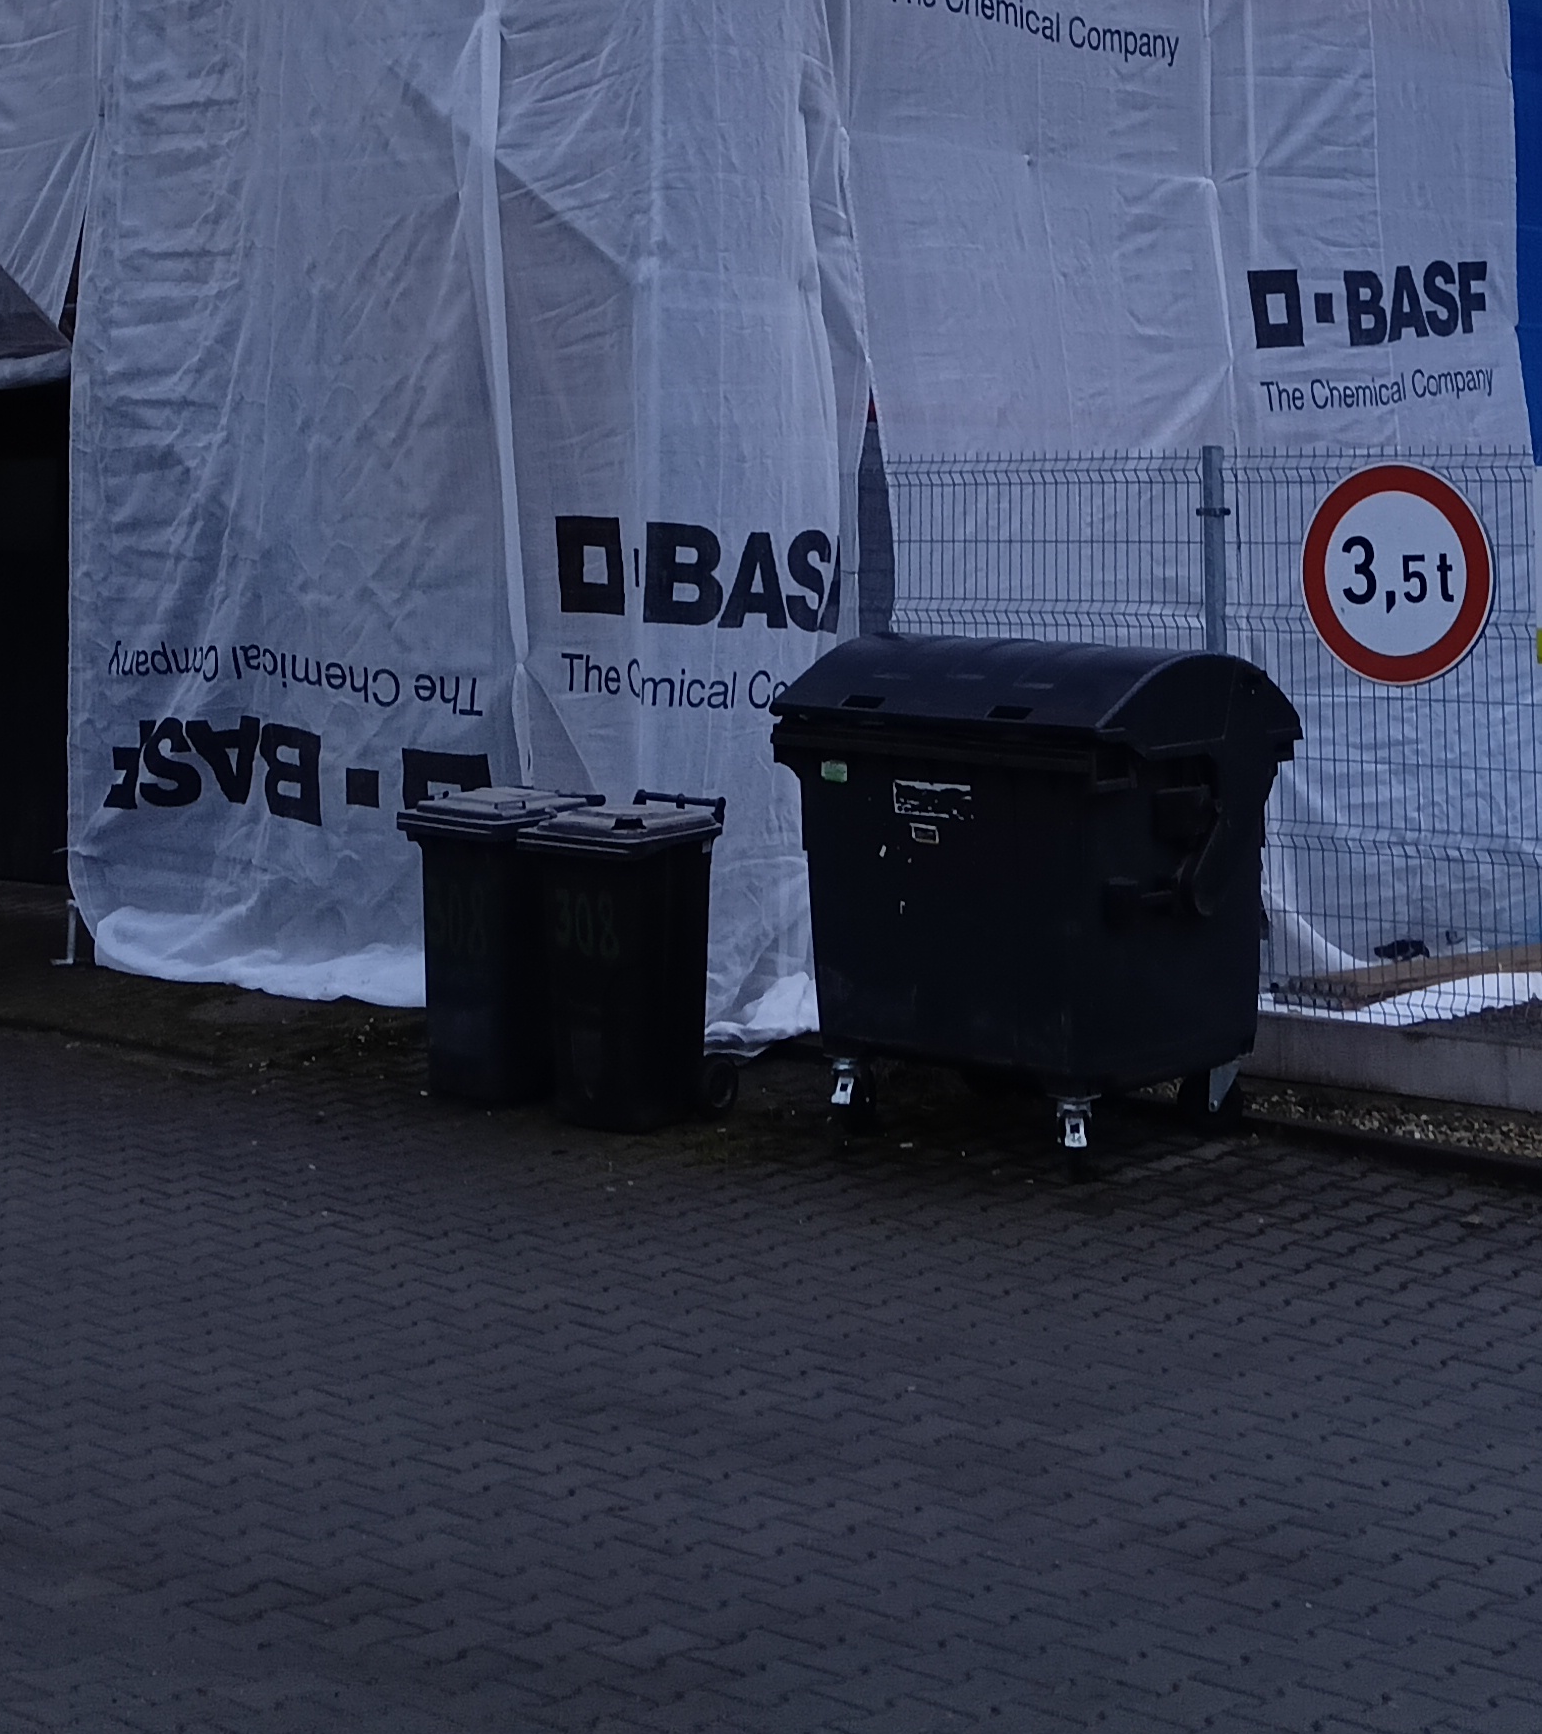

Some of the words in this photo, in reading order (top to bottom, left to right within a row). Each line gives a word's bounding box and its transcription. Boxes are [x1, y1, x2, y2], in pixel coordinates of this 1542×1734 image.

[1068, 16, 1180, 68] Company
[1343, 259, 1488, 347] BASF
[1261, 380, 1305, 412] The
[1312, 372, 1407, 411] Chemical
[1411, 366, 1494, 404] Company
[643, 521, 841, 634] BAS
[231, 645, 401, 707] Chemical
[414, 675, 483, 718] The
[561, 652, 621, 695] The
[103, 716, 322, 826] BASF
